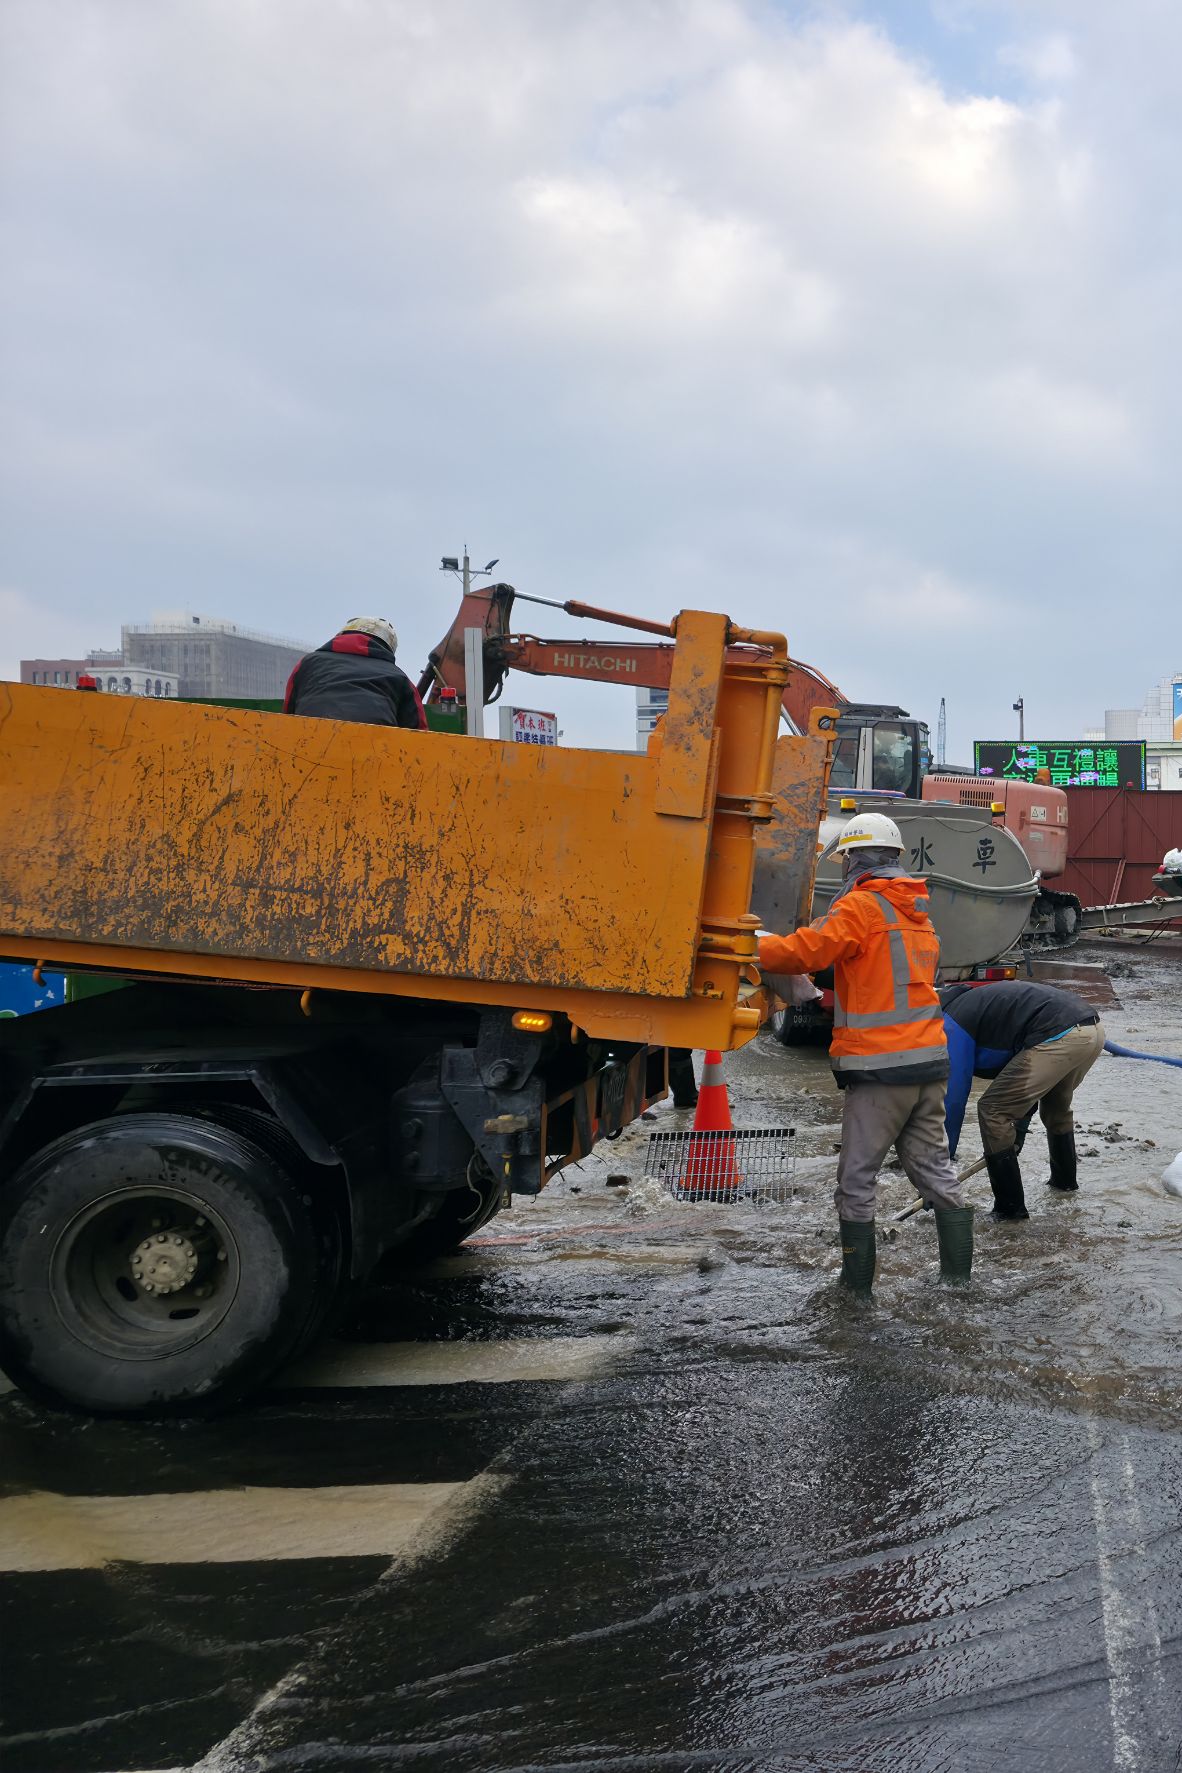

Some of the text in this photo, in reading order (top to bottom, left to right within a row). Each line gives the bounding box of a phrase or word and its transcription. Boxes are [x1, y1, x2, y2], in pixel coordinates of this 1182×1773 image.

[553, 652, 637, 673] HITACHI
[1003, 748, 1119, 772] 人車互禮讓
